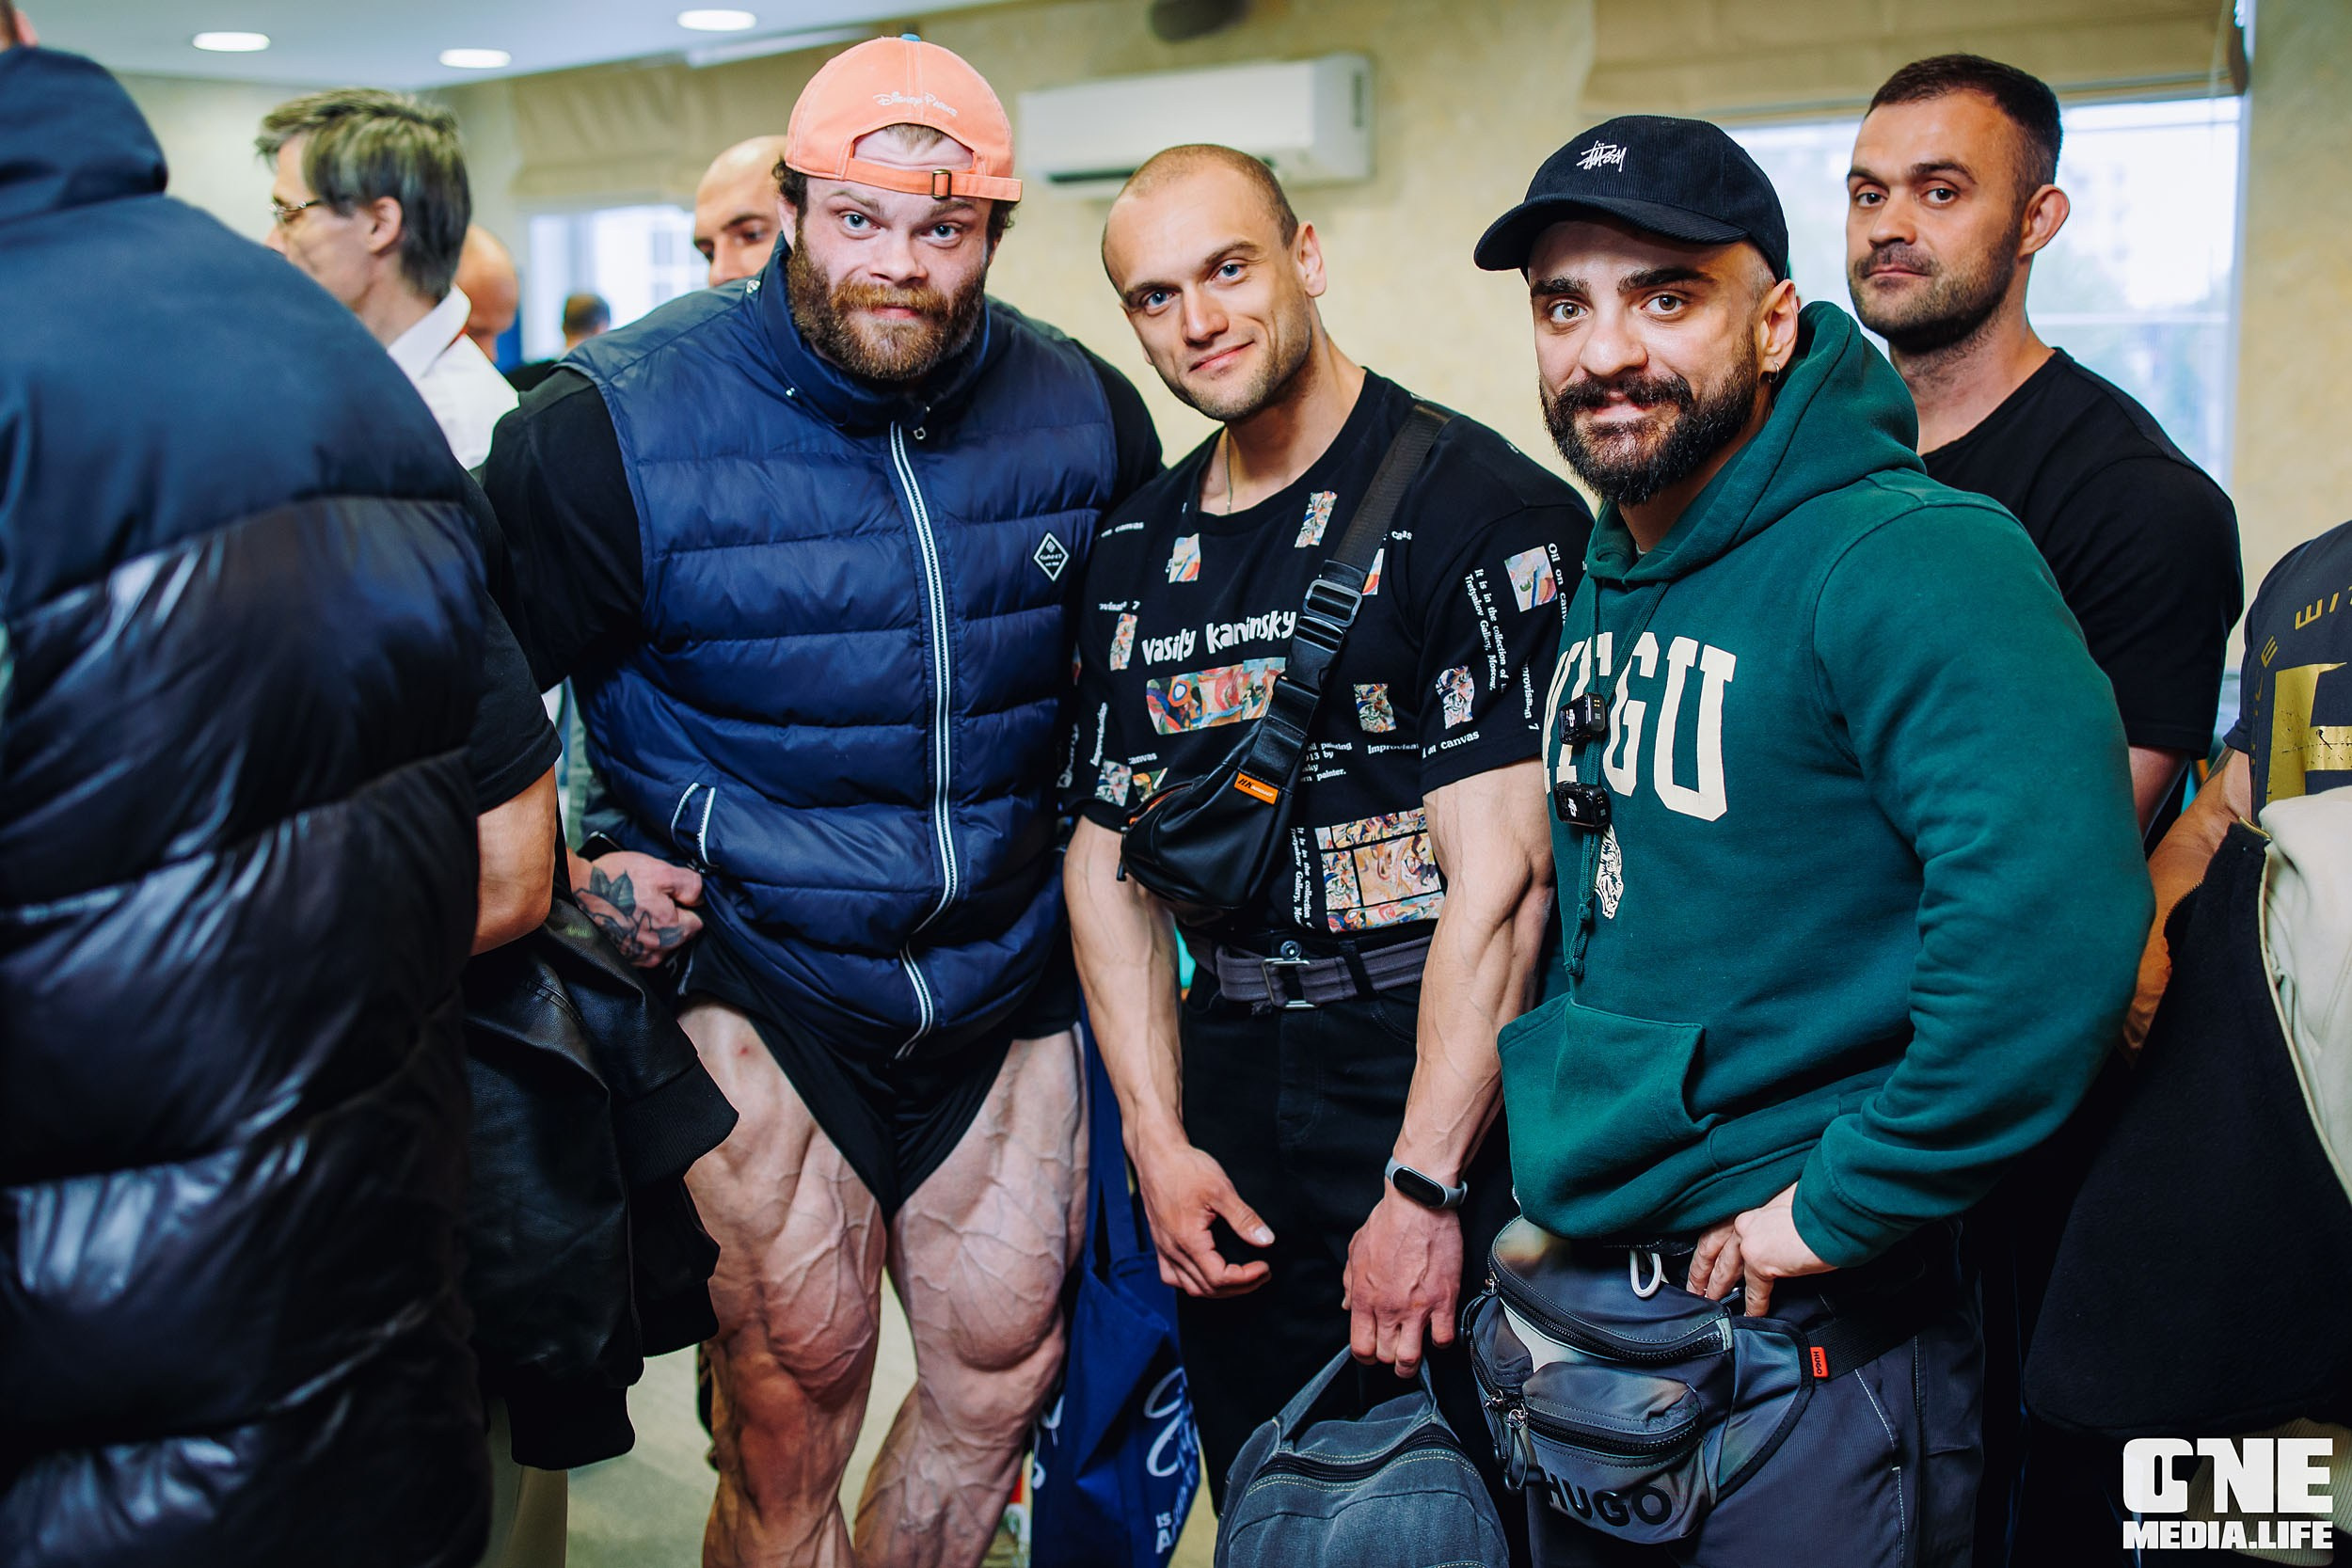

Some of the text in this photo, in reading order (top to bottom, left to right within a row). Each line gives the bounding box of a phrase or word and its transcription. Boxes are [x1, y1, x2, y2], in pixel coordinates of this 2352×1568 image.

[1548, 543, 1561, 562] Oil
[1555, 568, 1564, 586] on
[1478, 580, 1488, 590] is
[1465, 573, 1485, 617] Tretyakov
[1483, 593, 1492, 603] in
[1487, 606, 1498, 622] the
[1492, 625, 1507, 666] collection
[1500, 668, 1509, 679] of
[1440, 731, 1480, 750] canvas
[1813, 1351, 1823, 1375] HUGO
